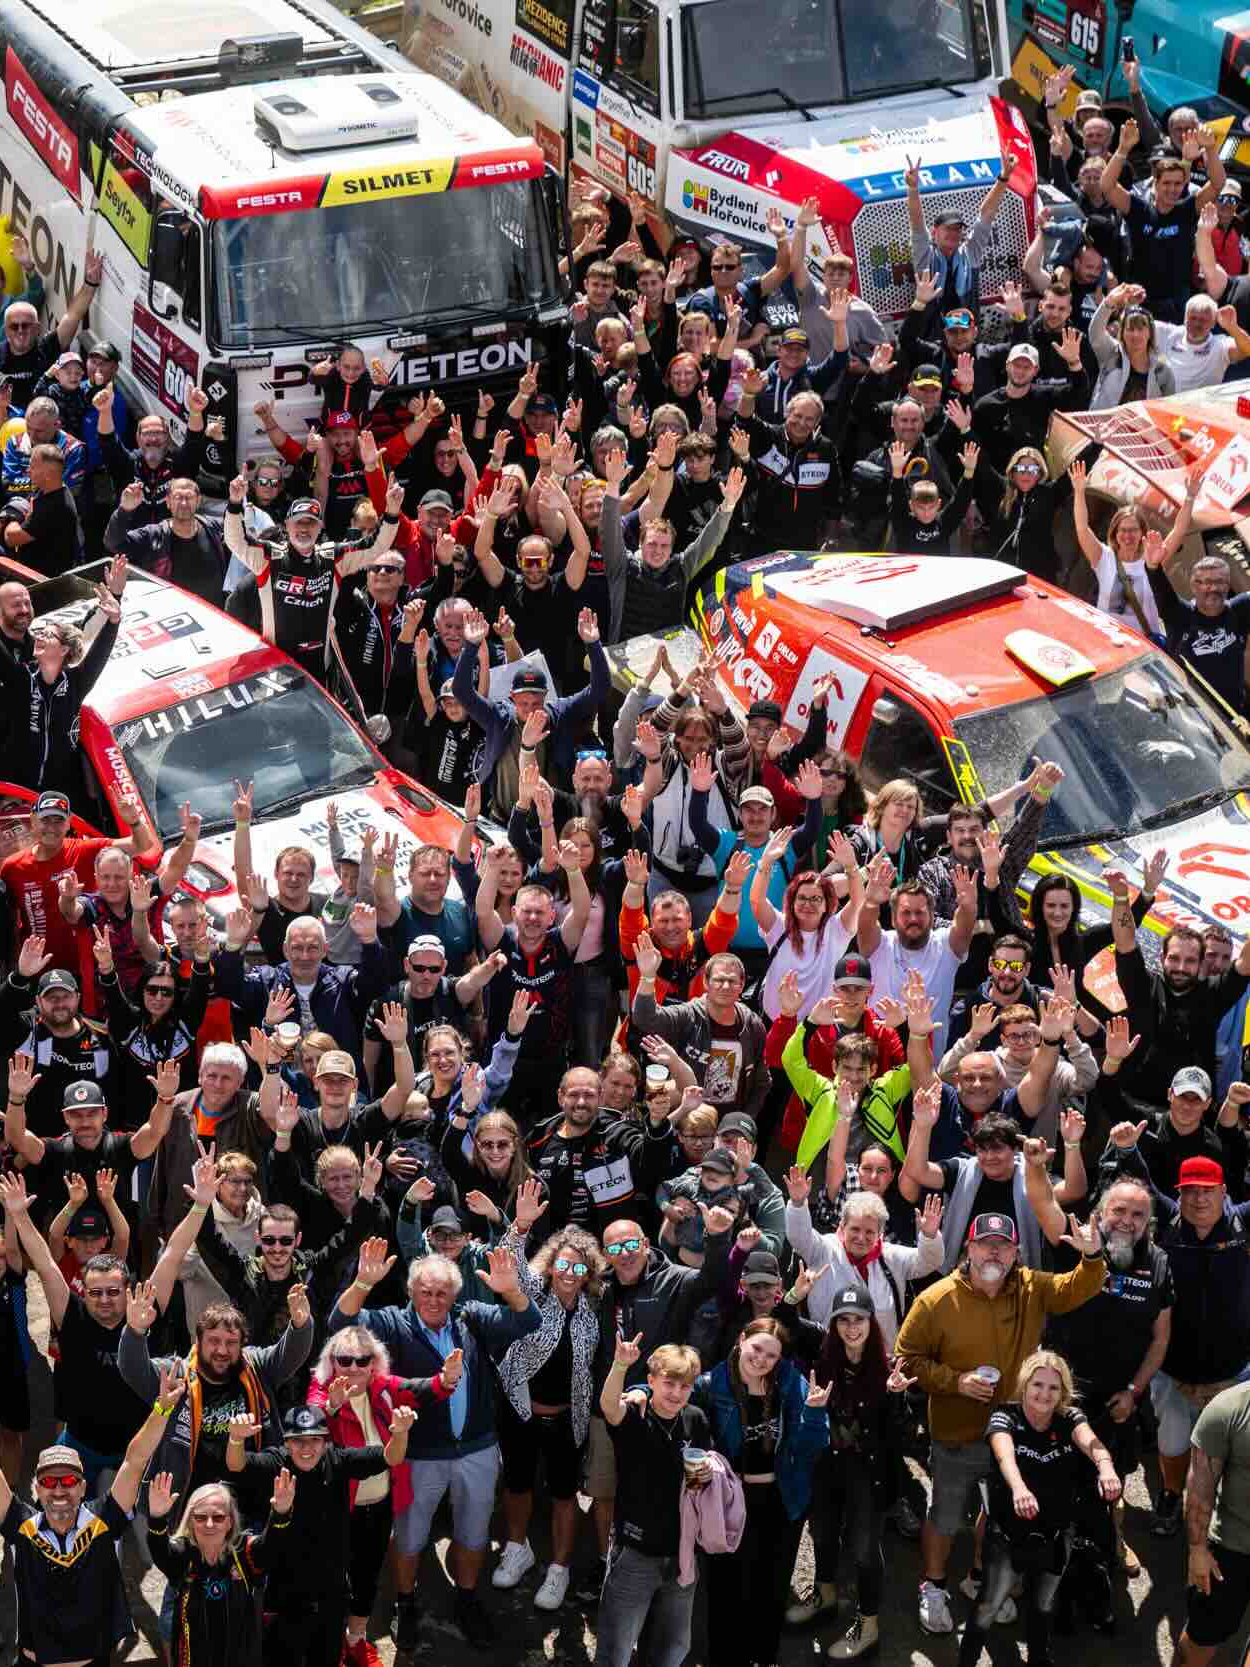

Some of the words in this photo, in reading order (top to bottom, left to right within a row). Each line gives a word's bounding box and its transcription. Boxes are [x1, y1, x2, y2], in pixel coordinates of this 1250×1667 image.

[1070, 12, 1100, 55] 615
[13, 80, 72, 171] FESTA
[136, 148, 193, 206] TECHNOLOGY
[471, 160, 531, 177] FESTA
[628, 155, 655, 201] 603
[699, 150, 751, 181] FRUM
[343, 169, 434, 194] SILMET
[237, 191, 302, 209] FESTA
[710, 188, 759, 215] Bydlení
[709, 204, 767, 233] Hořovice
[767, 304, 795, 315] BUILD
[276, 579, 305, 595] GR
[732, 606, 756, 637] verva
[776, 643, 799, 665] ORLEN
[141, 671, 287, 740] HILUX
[105, 747, 135, 795] MUSIC
[312, 821, 373, 847] DTA
